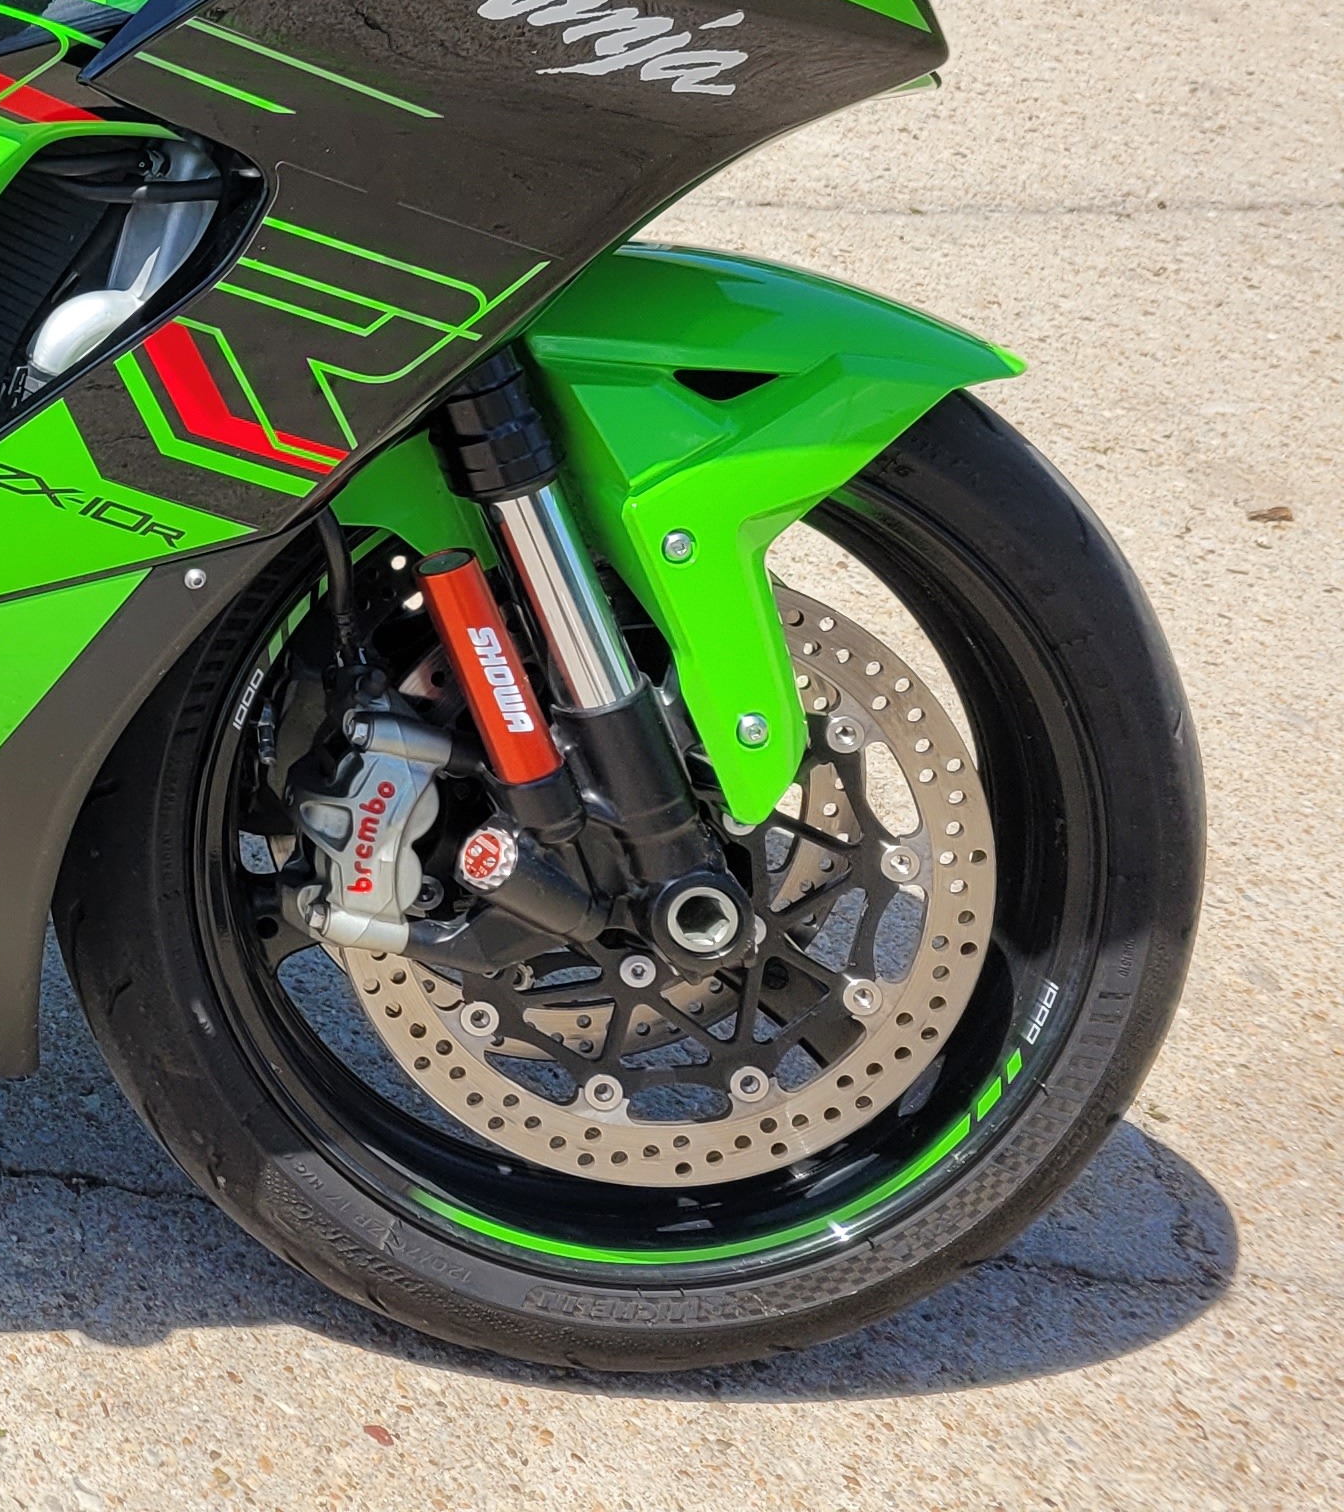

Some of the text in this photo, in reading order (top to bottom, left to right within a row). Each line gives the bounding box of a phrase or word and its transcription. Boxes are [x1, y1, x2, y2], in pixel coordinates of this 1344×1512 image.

[232, 668, 264, 730] 1000
[467, 627, 535, 733] SHOWA
[347, 781, 395, 894] brembo
[537, 1289, 709, 1322] MICHELIN
